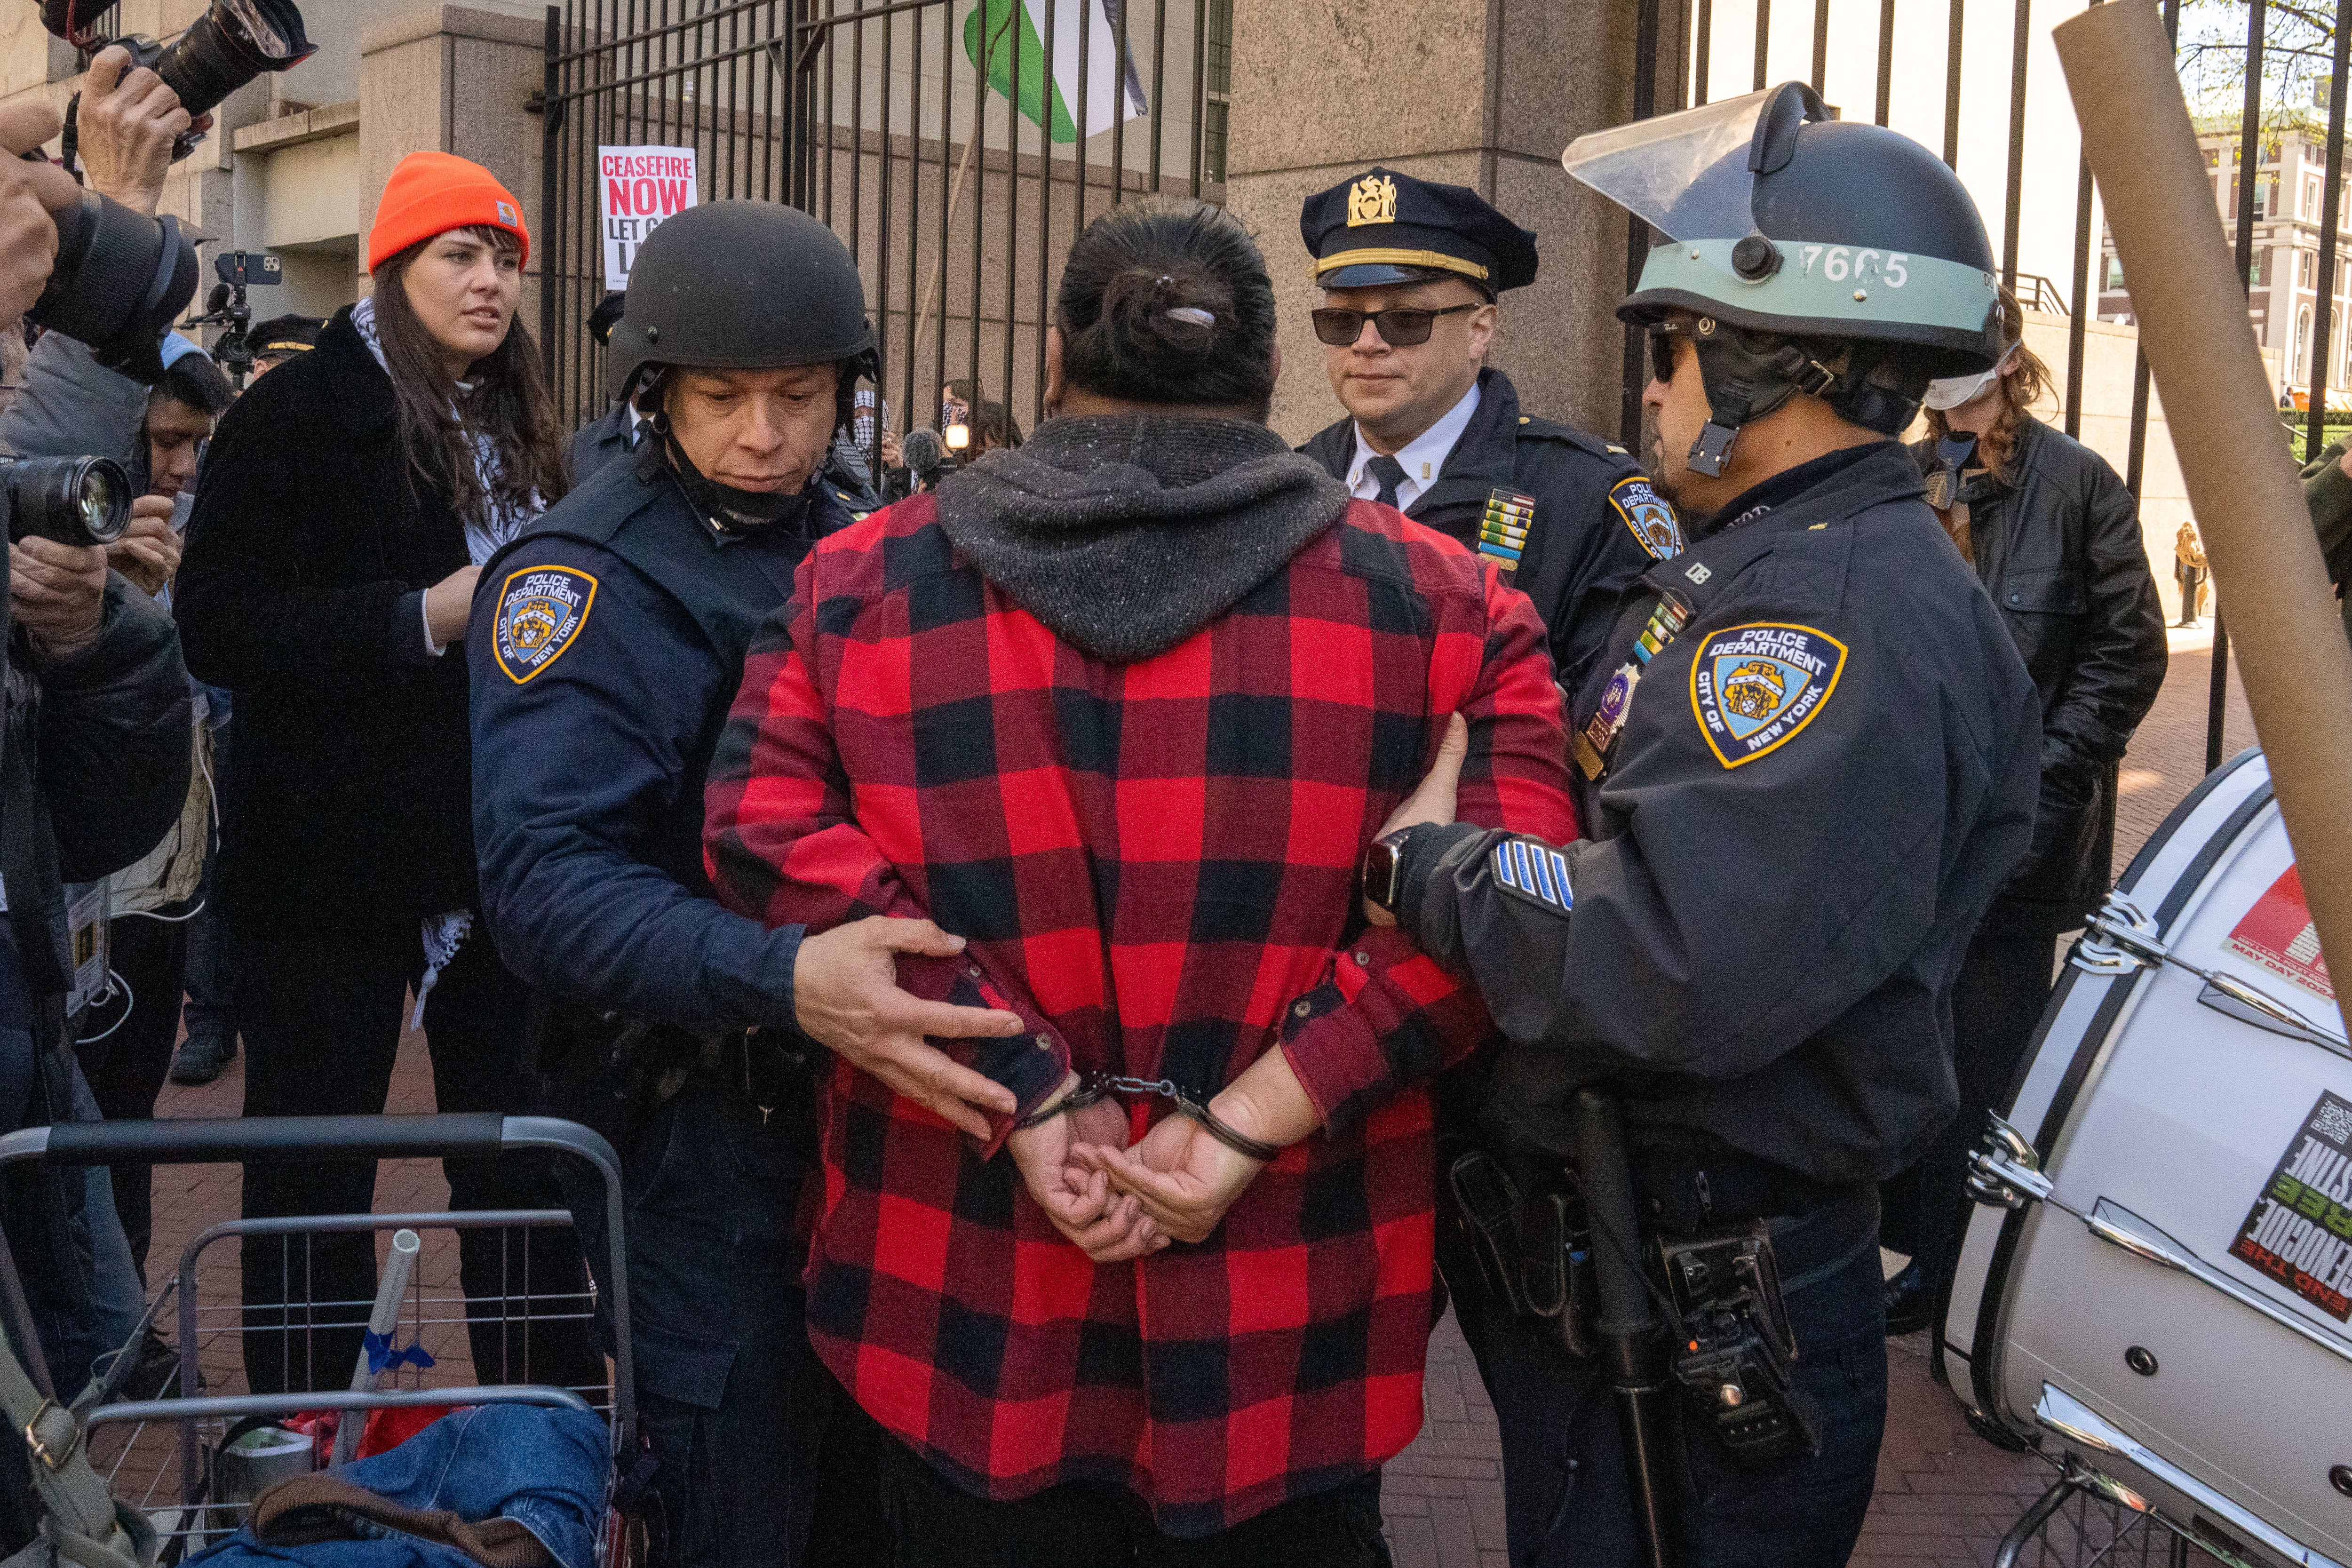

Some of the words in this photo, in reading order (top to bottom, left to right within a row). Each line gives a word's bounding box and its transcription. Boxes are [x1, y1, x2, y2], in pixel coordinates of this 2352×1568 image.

[602, 155, 692, 178] CEASEFIRE
[608, 178, 687, 216] NOW
[609, 218, 640, 240] LET
[1631, 520, 1650, 545] CITY
[525, 574, 571, 589] POLICE
[504, 585, 581, 607] DEPARTMENT
[499, 617, 508, 643] CITY
[531, 645, 555, 667] NEW
[552, 614, 579, 644] YORK
[1740, 629, 1808, 651] POLICE
[502, 645, 515, 660] OF
[1708, 642, 1827, 677] DEPARTMENT
[1698, 671, 1715, 706] CITY
[1705, 709, 1725, 733] OF
[1747, 722, 1783, 751] NEW
[1782, 685, 1823, 725] YORK
[2231, 943, 2264, 961] MAY
[2265, 960, 2295, 978] DAY
[2239, 1239, 2287, 1277] THE
